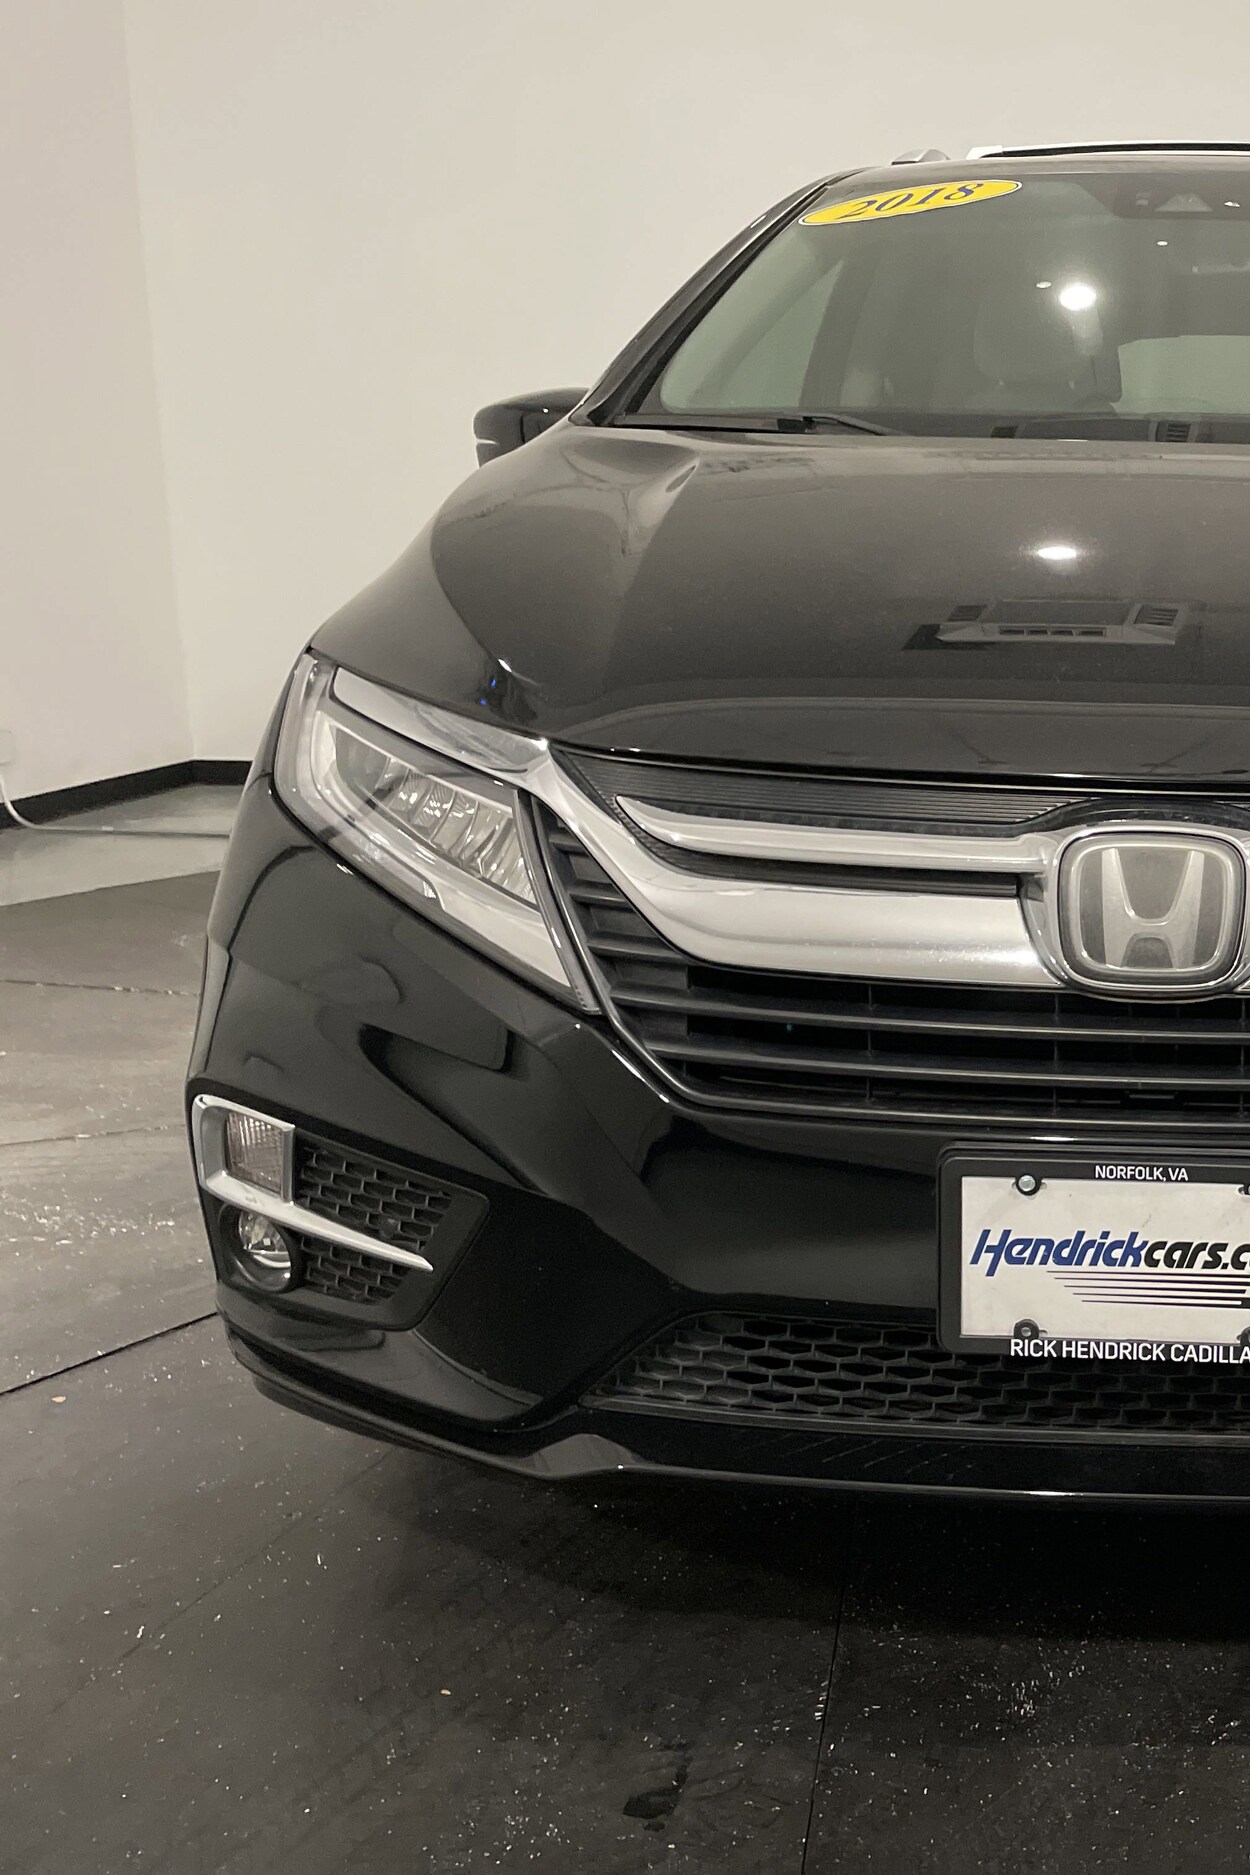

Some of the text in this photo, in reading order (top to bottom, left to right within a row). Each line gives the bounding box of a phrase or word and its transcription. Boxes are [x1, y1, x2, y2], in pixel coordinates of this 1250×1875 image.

[835, 183, 984, 220] 2018
[1095, 1165, 1189, 1182] NORFOLK, VA
[1010, 1338, 1057, 1357] RICK
[1062, 1340, 1166, 1361] HENDRICK
